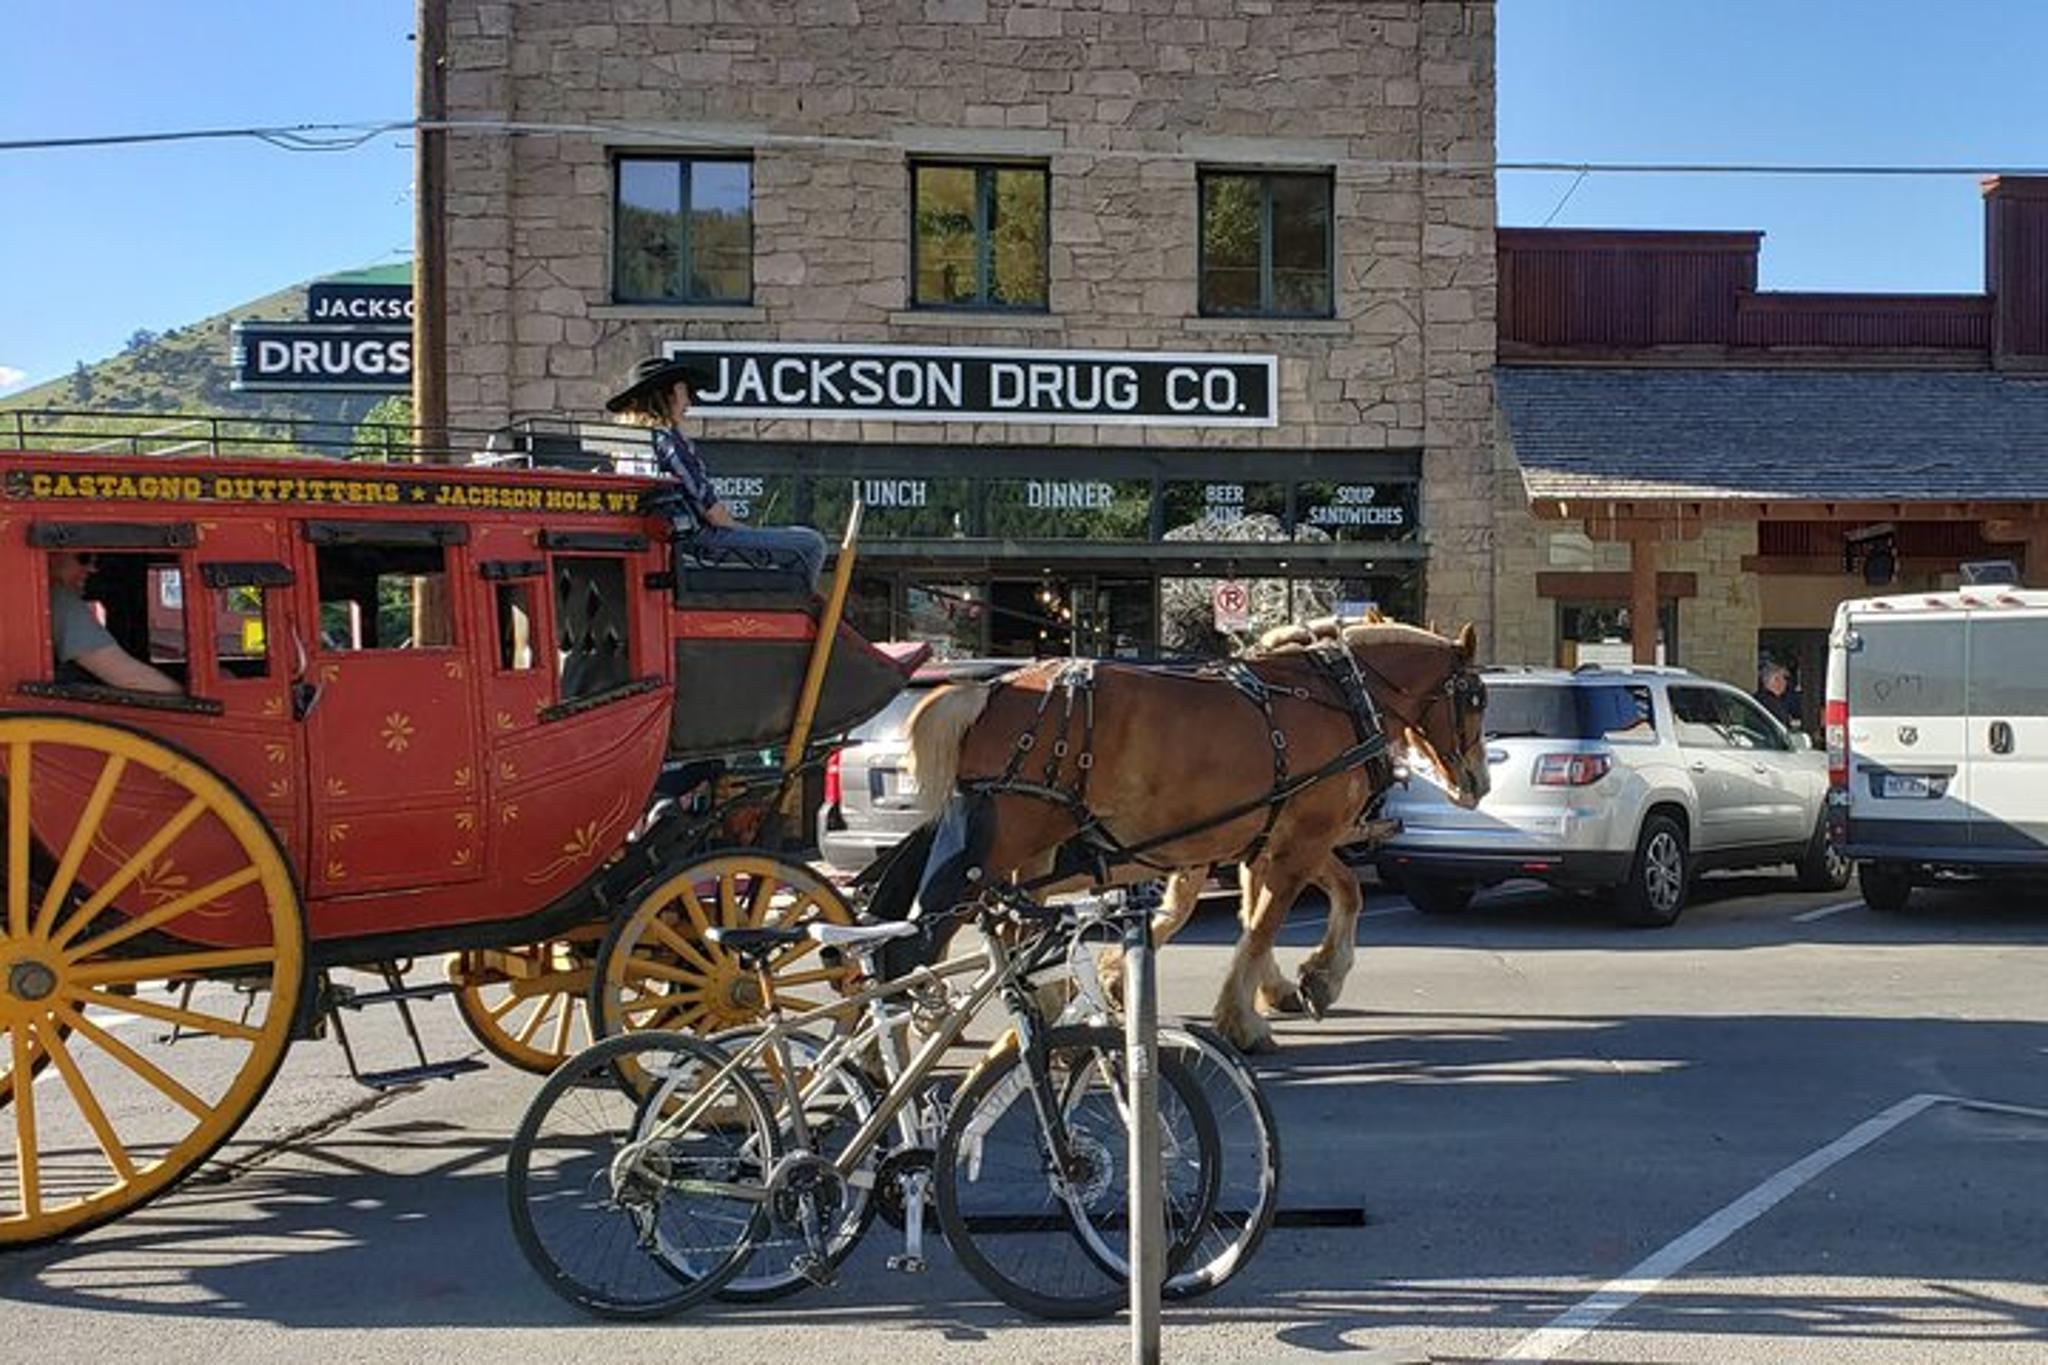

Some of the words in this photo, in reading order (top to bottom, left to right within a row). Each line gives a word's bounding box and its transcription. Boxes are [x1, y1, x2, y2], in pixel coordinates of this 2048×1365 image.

[258, 340, 411, 374] DRUGS
[696, 357, 962, 406] JACKSON
[990, 363, 1139, 411] DRUG
[1165, 367, 1246, 413] CO.
[31, 474, 201, 499] CASTAGNO
[214, 478, 399, 502] OUTFITTERS
[434, 485, 542, 508] JACKSON
[546, 490, 601, 510] HOLE
[607, 493, 639, 512] WY
[709, 477, 764, 496] RGERS
[853, 480, 926, 506] LUNCH
[1027, 483, 1112, 508] DINNER
[1205, 485, 1244, 503] BEER
[1336, 486, 1375, 504] SOUP
[1309, 507, 1403, 525] SANDWICHES
